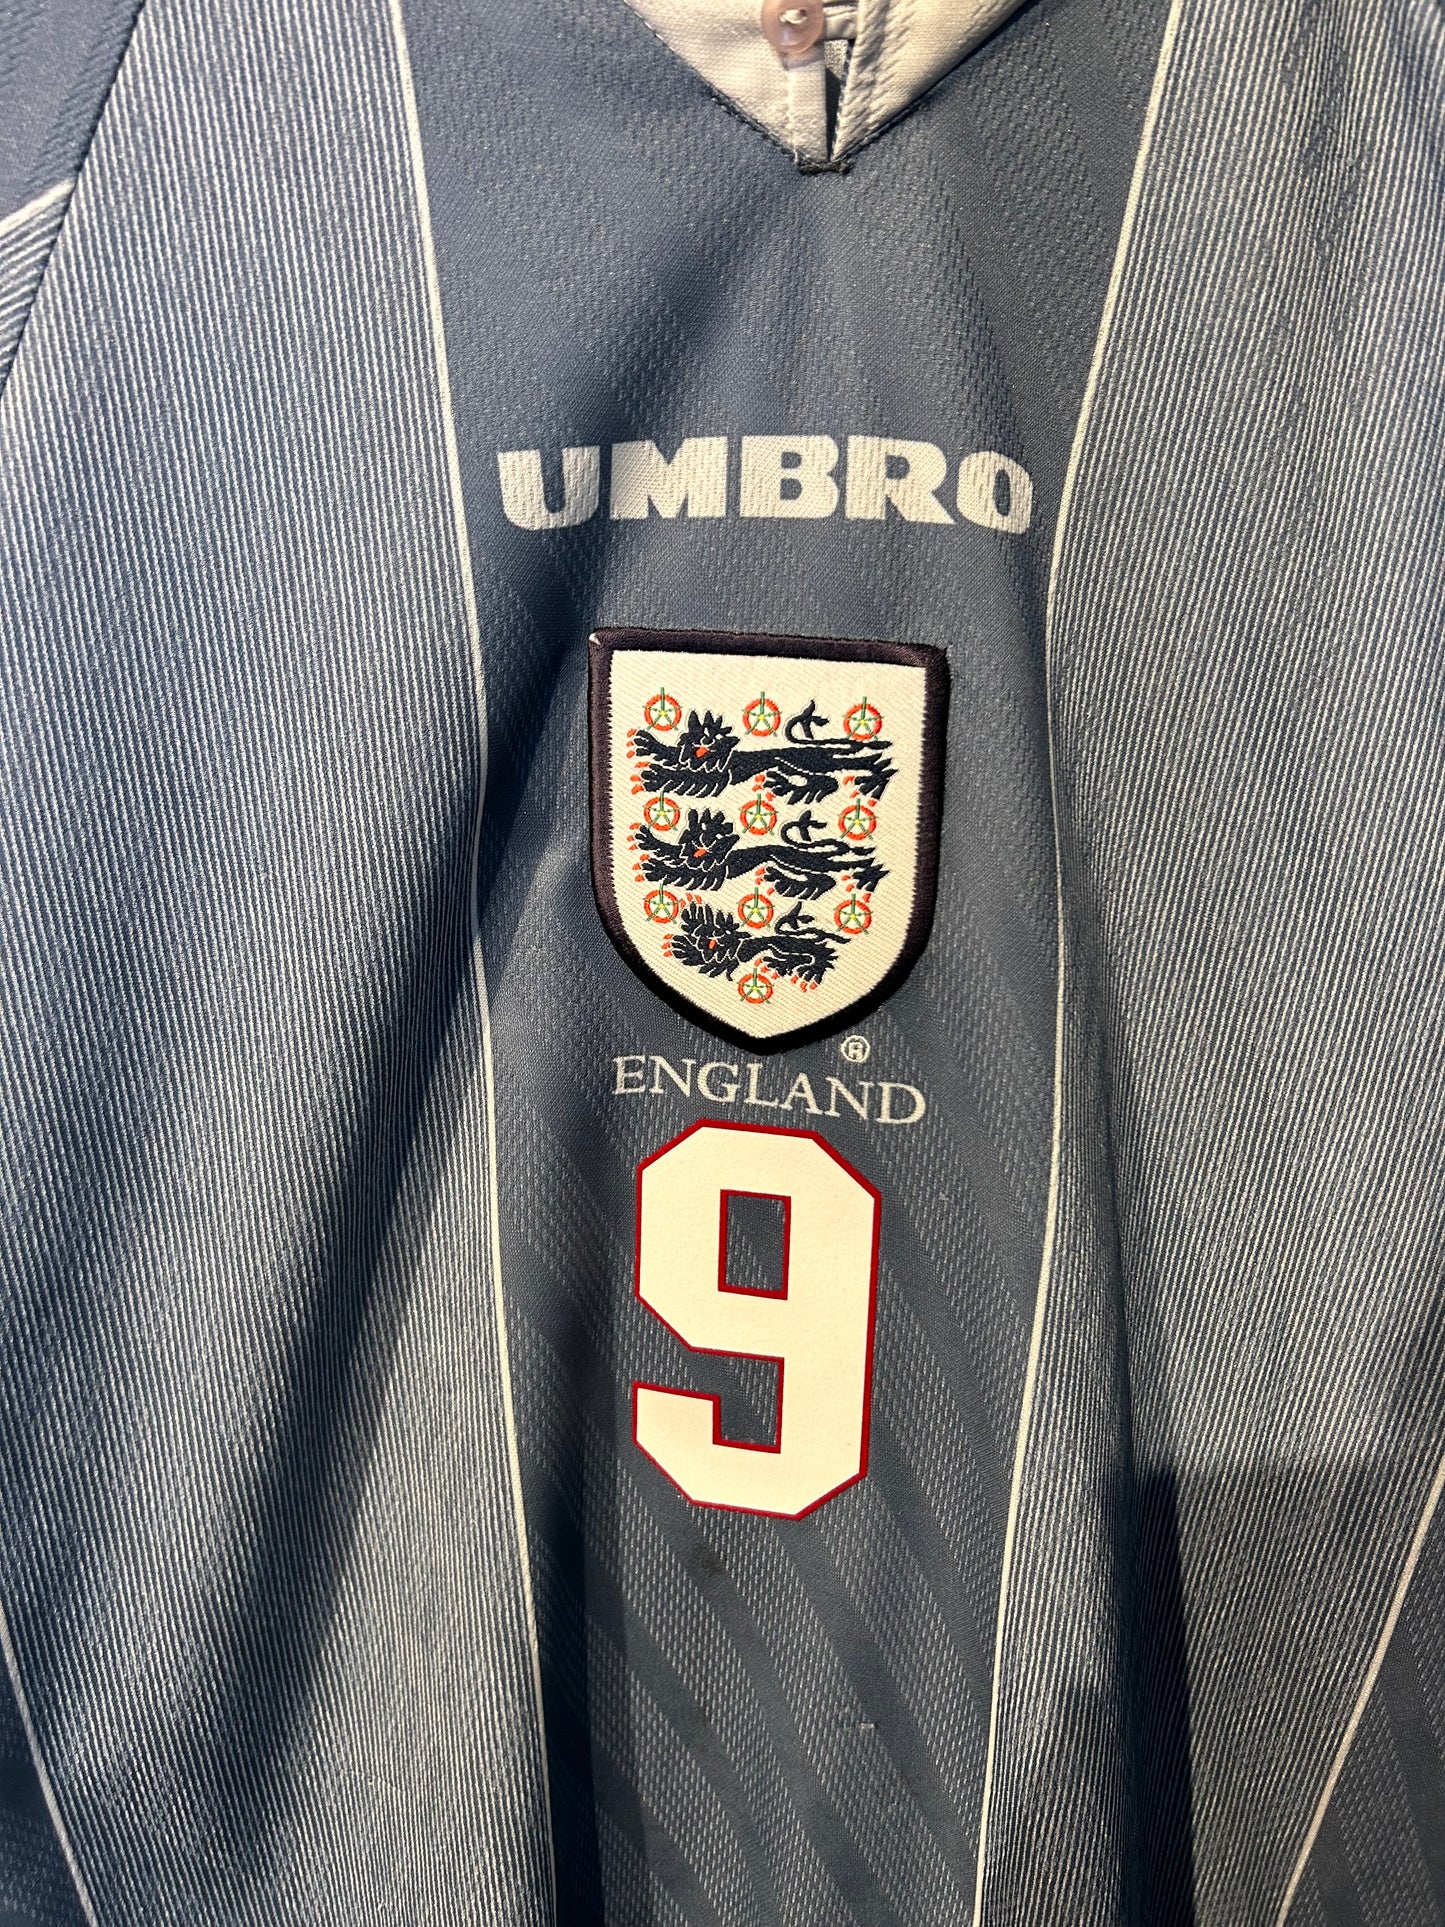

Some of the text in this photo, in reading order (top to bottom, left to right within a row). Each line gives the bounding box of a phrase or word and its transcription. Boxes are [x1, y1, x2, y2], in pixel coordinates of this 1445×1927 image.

[497, 434, 1033, 534] UMBRO
[611, 1054, 926, 1124] ENGLAND
[632, 1118, 882, 1521] 9
